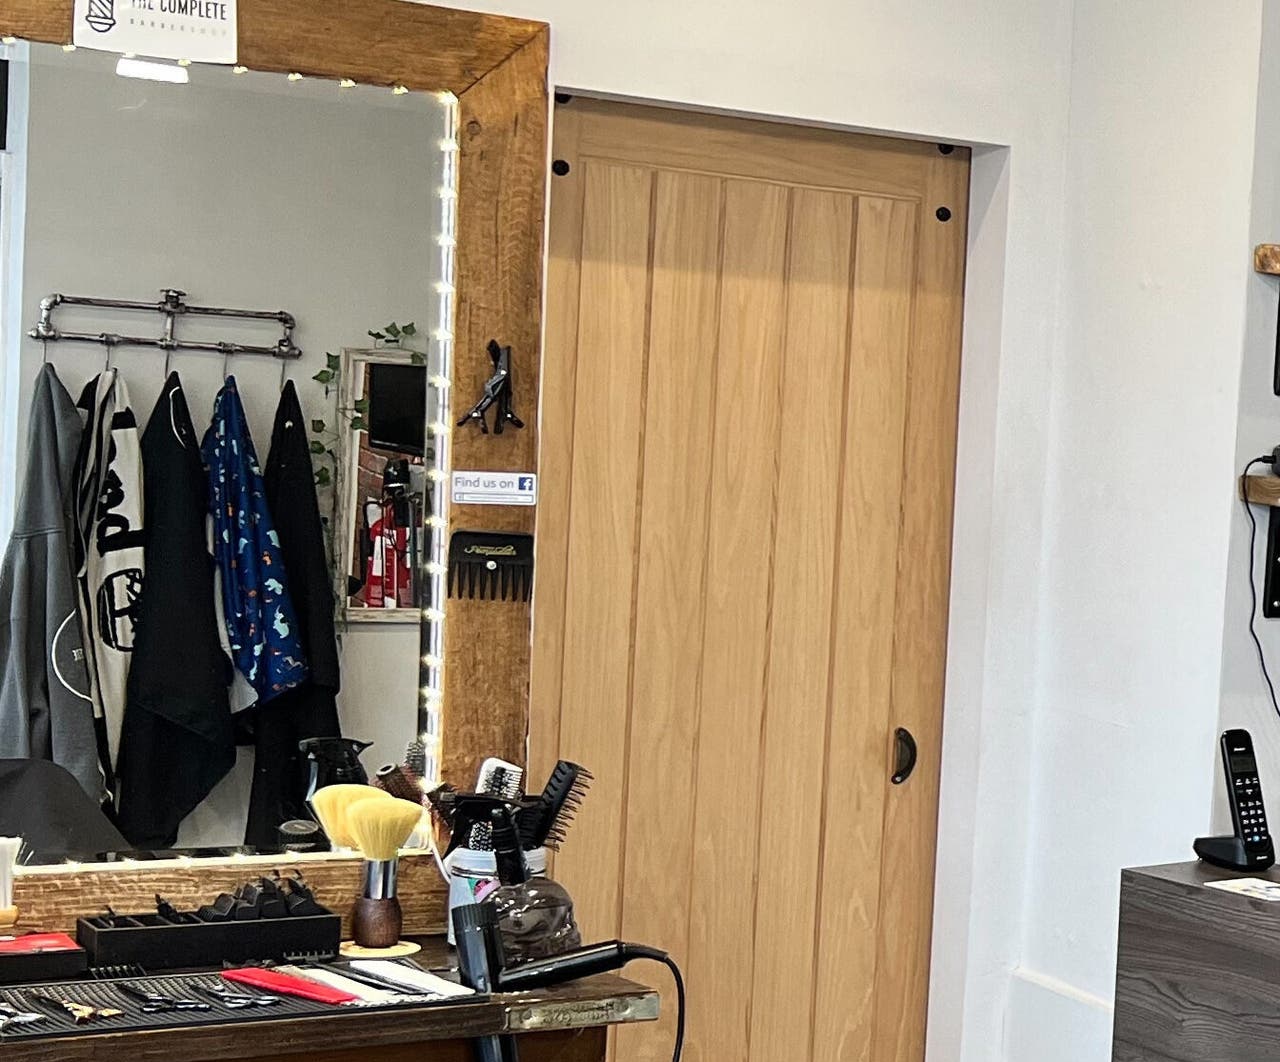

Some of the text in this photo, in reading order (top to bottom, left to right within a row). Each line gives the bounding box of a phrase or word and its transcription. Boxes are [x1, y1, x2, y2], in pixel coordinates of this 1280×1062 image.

[160, 0, 227, 20] COMPLETE
[454, 476, 481, 488] Find
[483, 481, 497, 489] us
[499, 480, 514, 489] on
